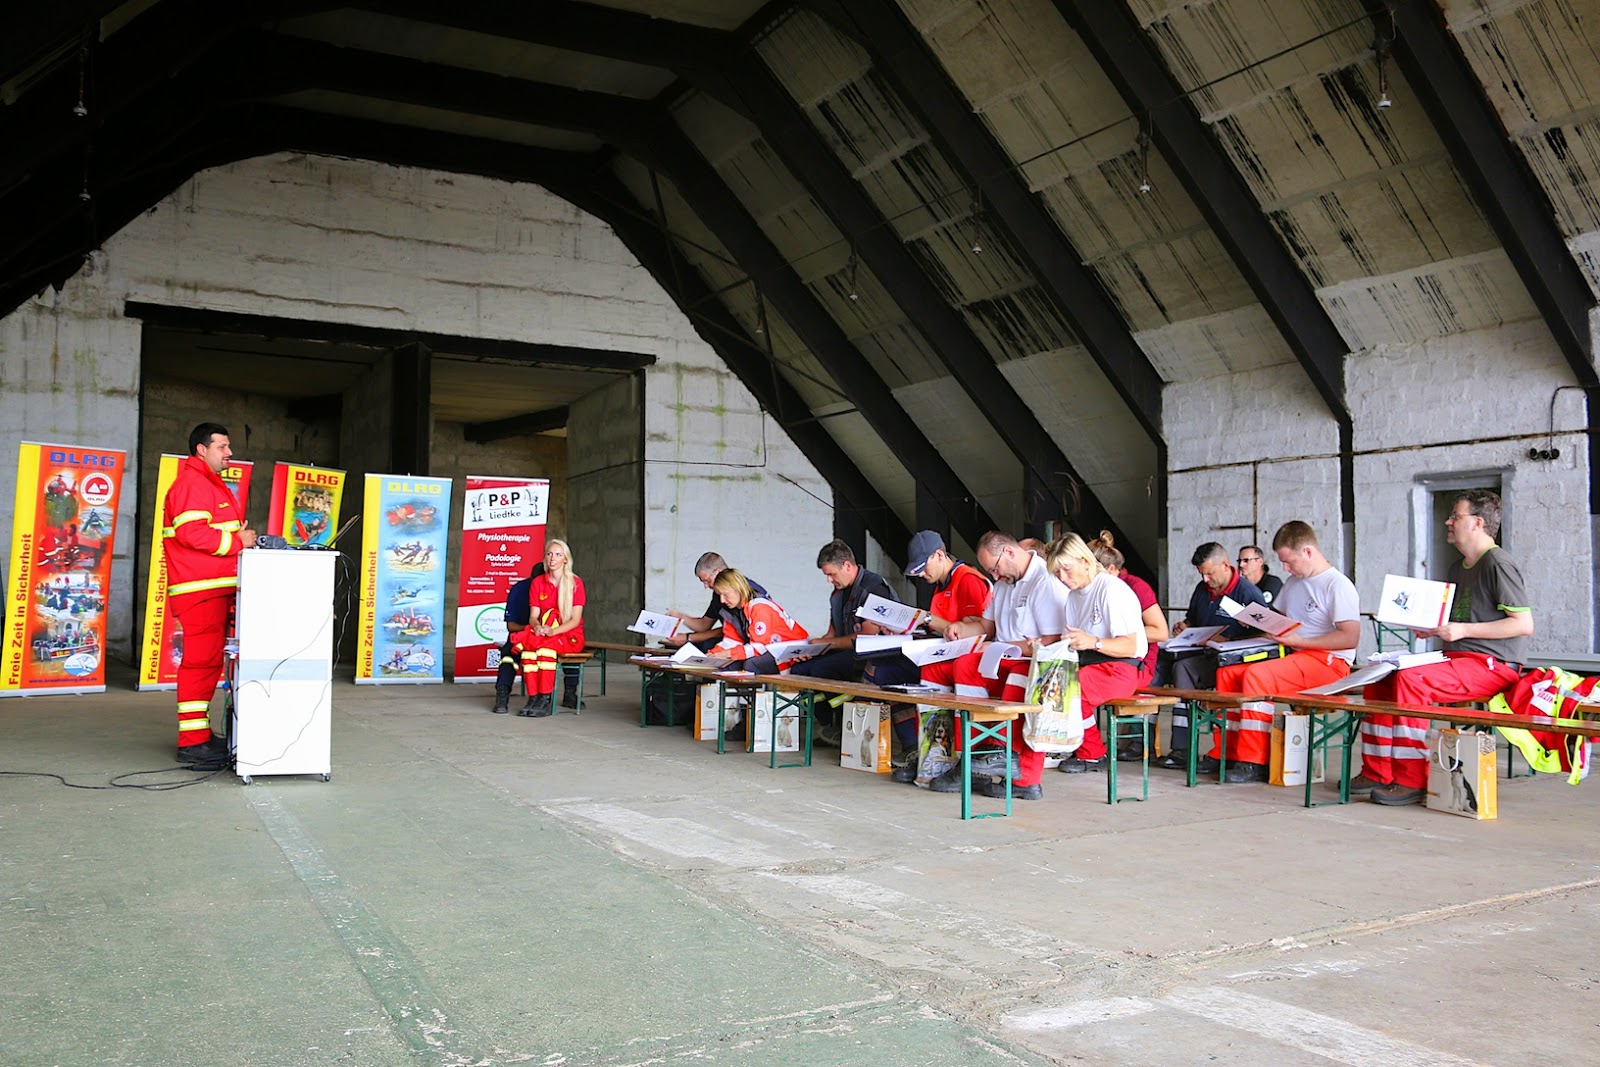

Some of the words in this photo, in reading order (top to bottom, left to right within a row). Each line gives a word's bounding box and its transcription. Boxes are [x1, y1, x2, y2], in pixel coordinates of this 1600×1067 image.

[50, 451, 115, 467] DLRG
[294, 470, 339, 486] DLRG
[387, 481, 442, 494] DLRG
[488, 491, 521, 507] P&P
[489, 510, 521, 520] Liedtke
[477, 532, 531, 543] Physiotherapie
[499, 543, 507, 552] &
[16, 533, 31, 601] Sicherheit
[485, 553, 522, 565] Podologie
[366, 550, 377, 608] Sicherheit
[14, 606, 25, 617] in
[154, 606, 163, 618] in
[365, 610, 375, 622] in
[12, 622, 24, 648] Zeit
[151, 621, 162, 646] Zeit
[364, 624, 374, 647] Zeit
[9, 652, 21, 685] Freie
[147, 657, 159, 680] Freie
[363, 650, 373, 678] Freie
